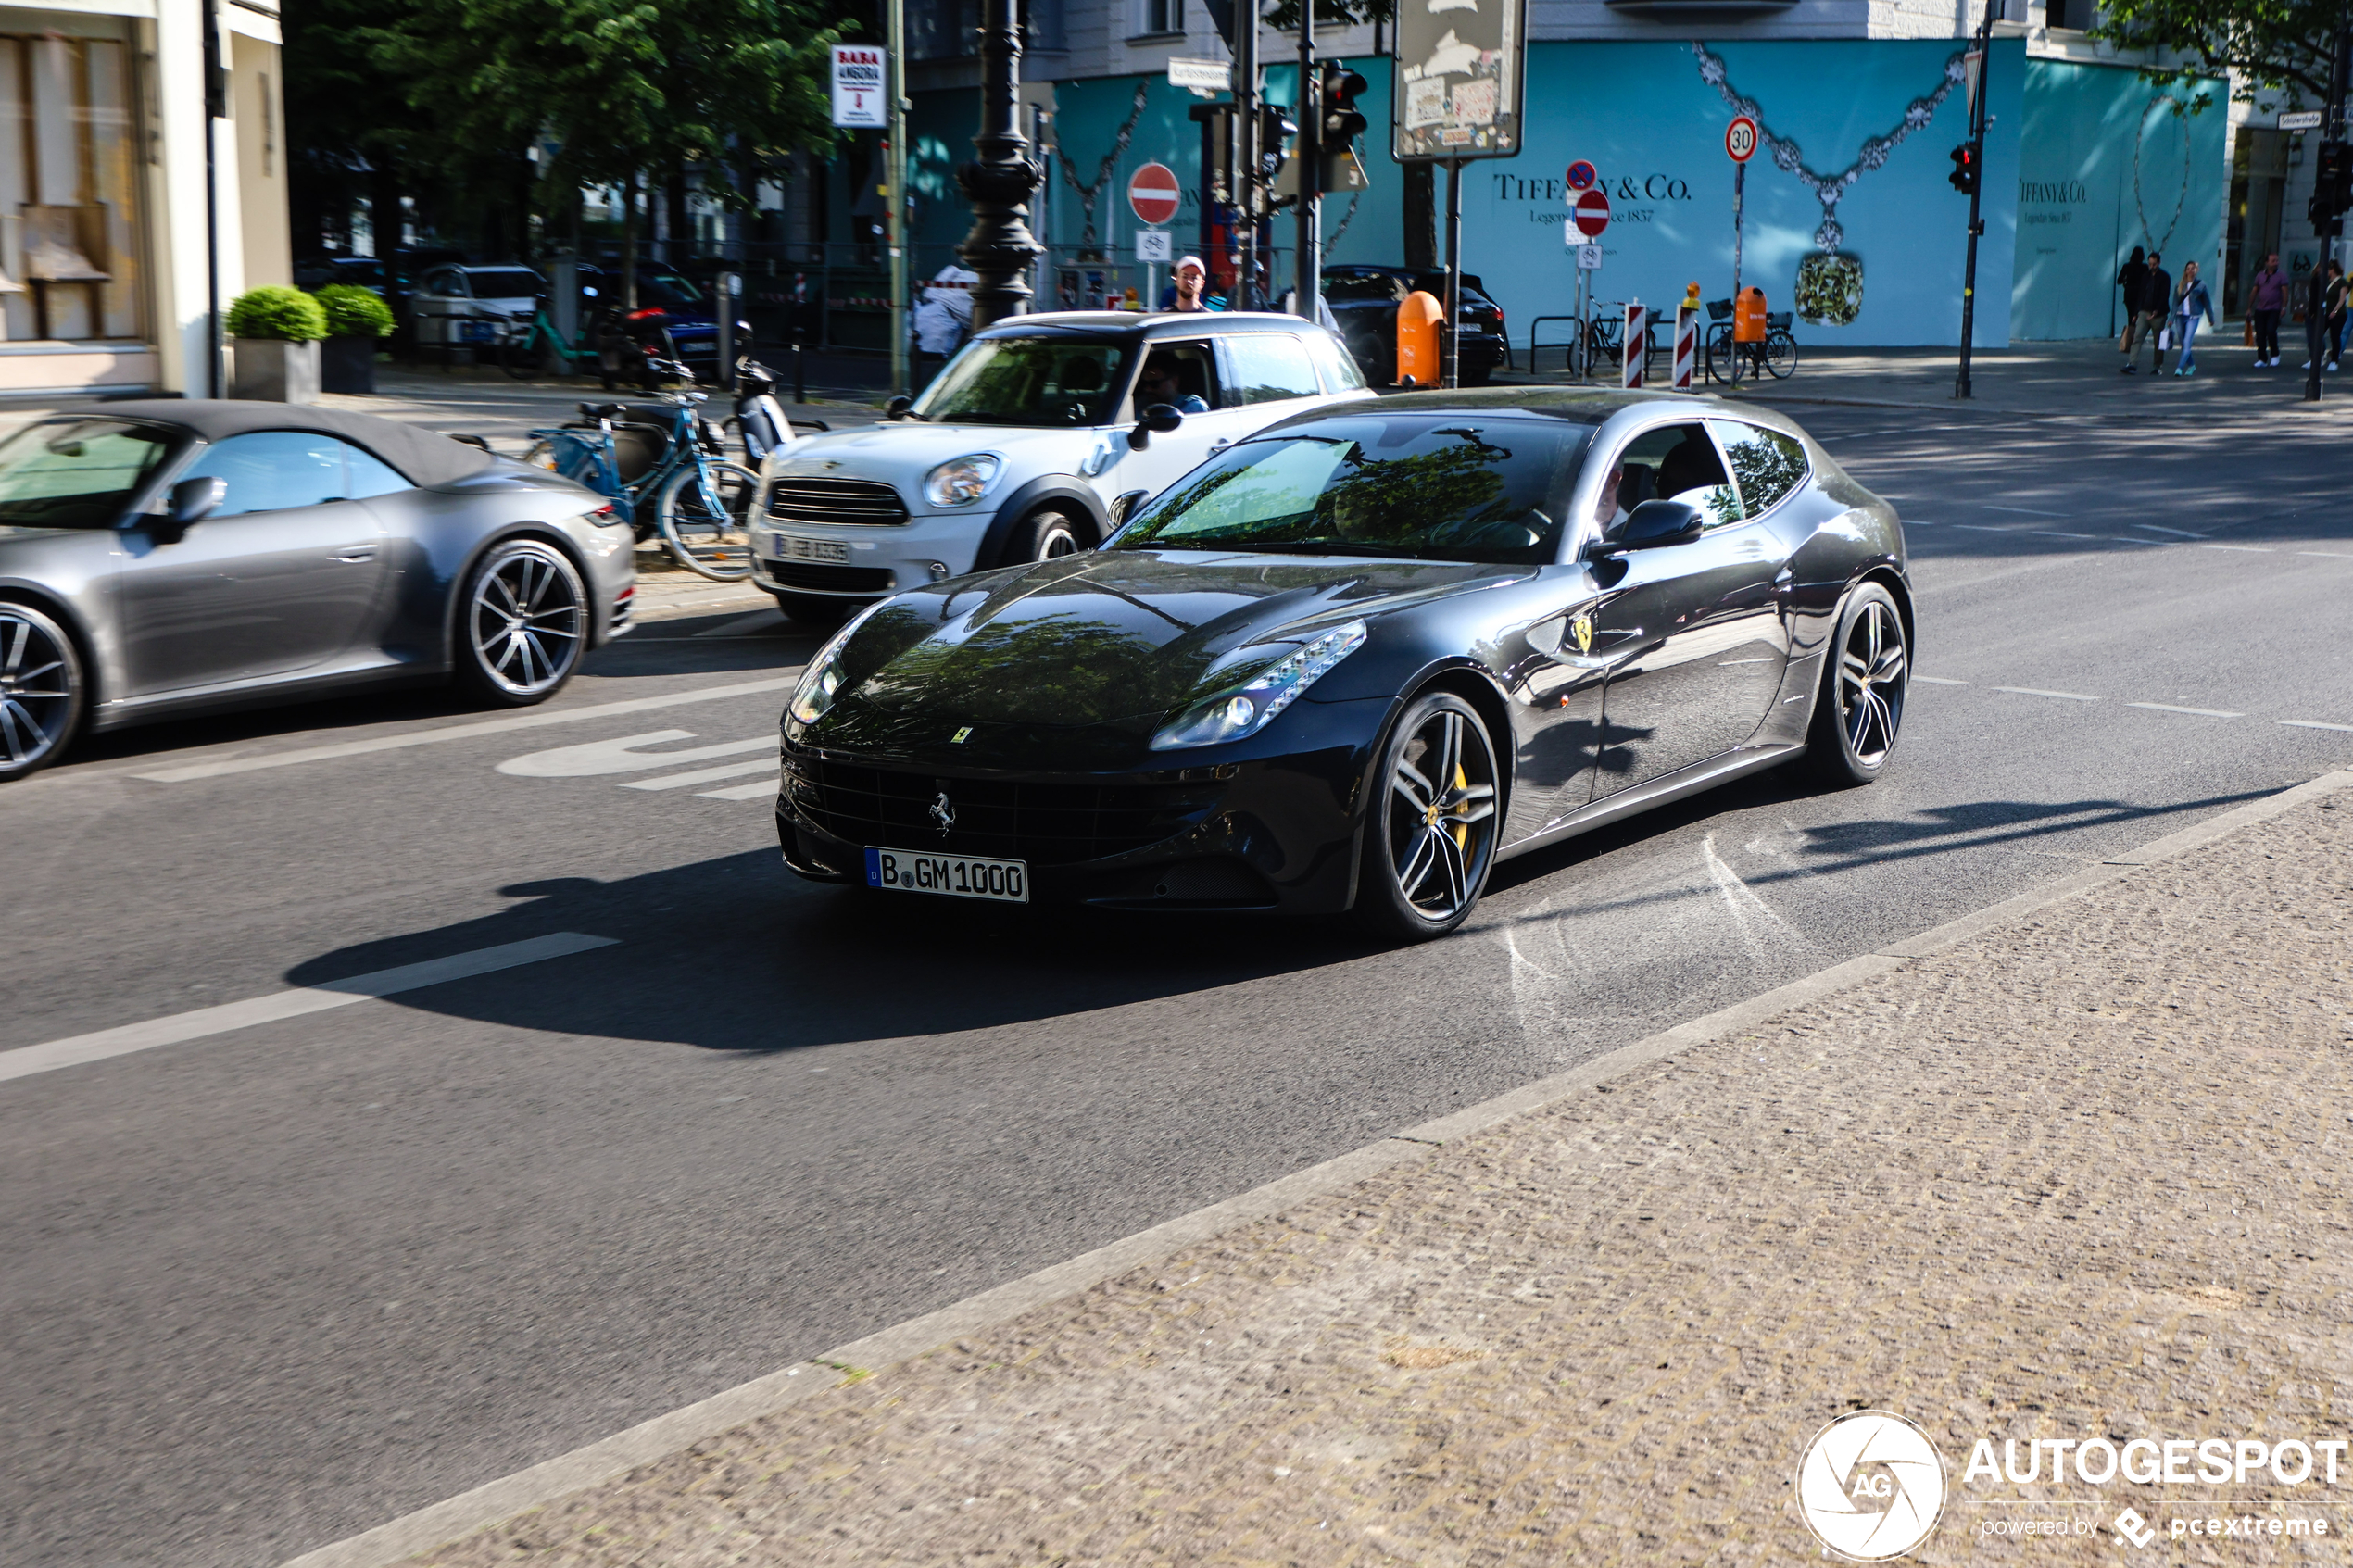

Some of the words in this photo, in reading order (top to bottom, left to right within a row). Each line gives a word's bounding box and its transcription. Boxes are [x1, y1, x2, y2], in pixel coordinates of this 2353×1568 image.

[837, 50, 879, 65] BABA
[1732, 130, 1751, 150] 30
[1617, 175, 1638, 200] &
[2019, 177, 2058, 203] IFFANY
[1628, 209, 1655, 223] 1837
[871, 871, 877, 880] D
[881, 853, 899, 884] B
